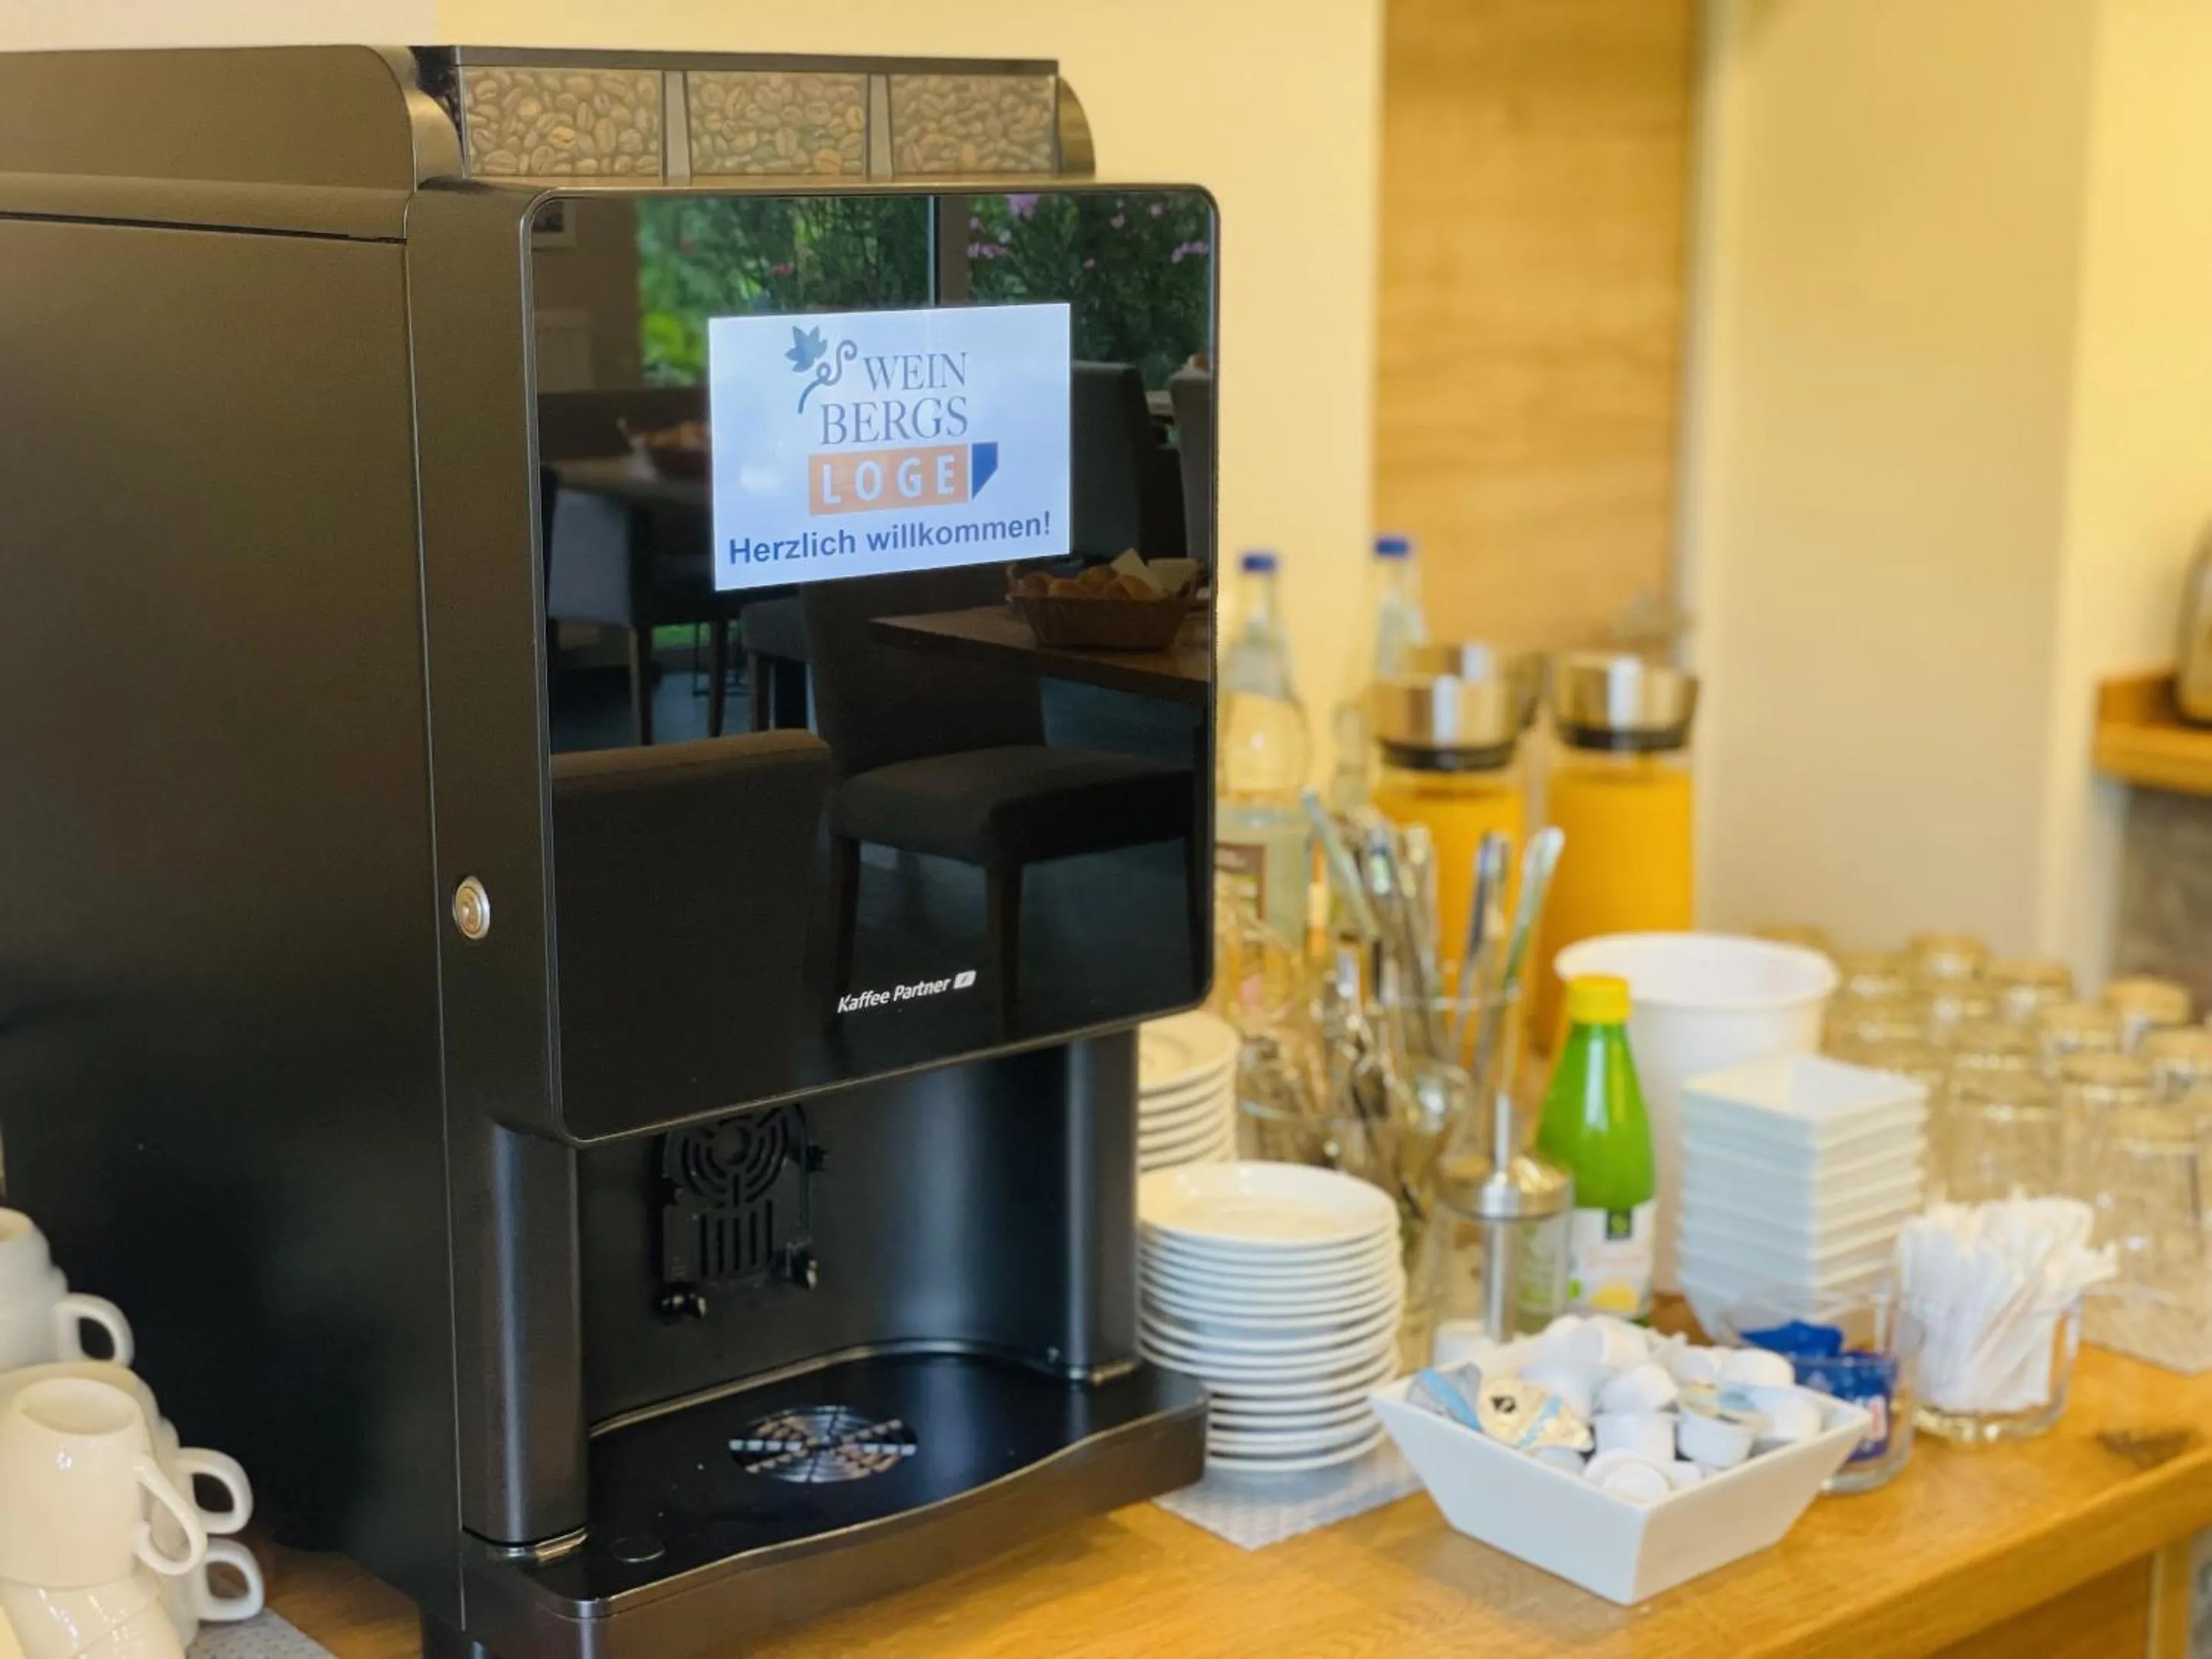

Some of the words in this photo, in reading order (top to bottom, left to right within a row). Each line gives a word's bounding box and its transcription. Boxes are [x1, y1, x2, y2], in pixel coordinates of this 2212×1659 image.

[862, 352, 968, 392] WEIN
[820, 396, 969, 445] BERGS
[821, 454, 956, 504] LOGE
[729, 530, 856, 565] Herzlich
[866, 511, 1051, 552] willkommen!
[837, 990, 891, 1013] Kaffee
[893, 978, 952, 1002] Partner
